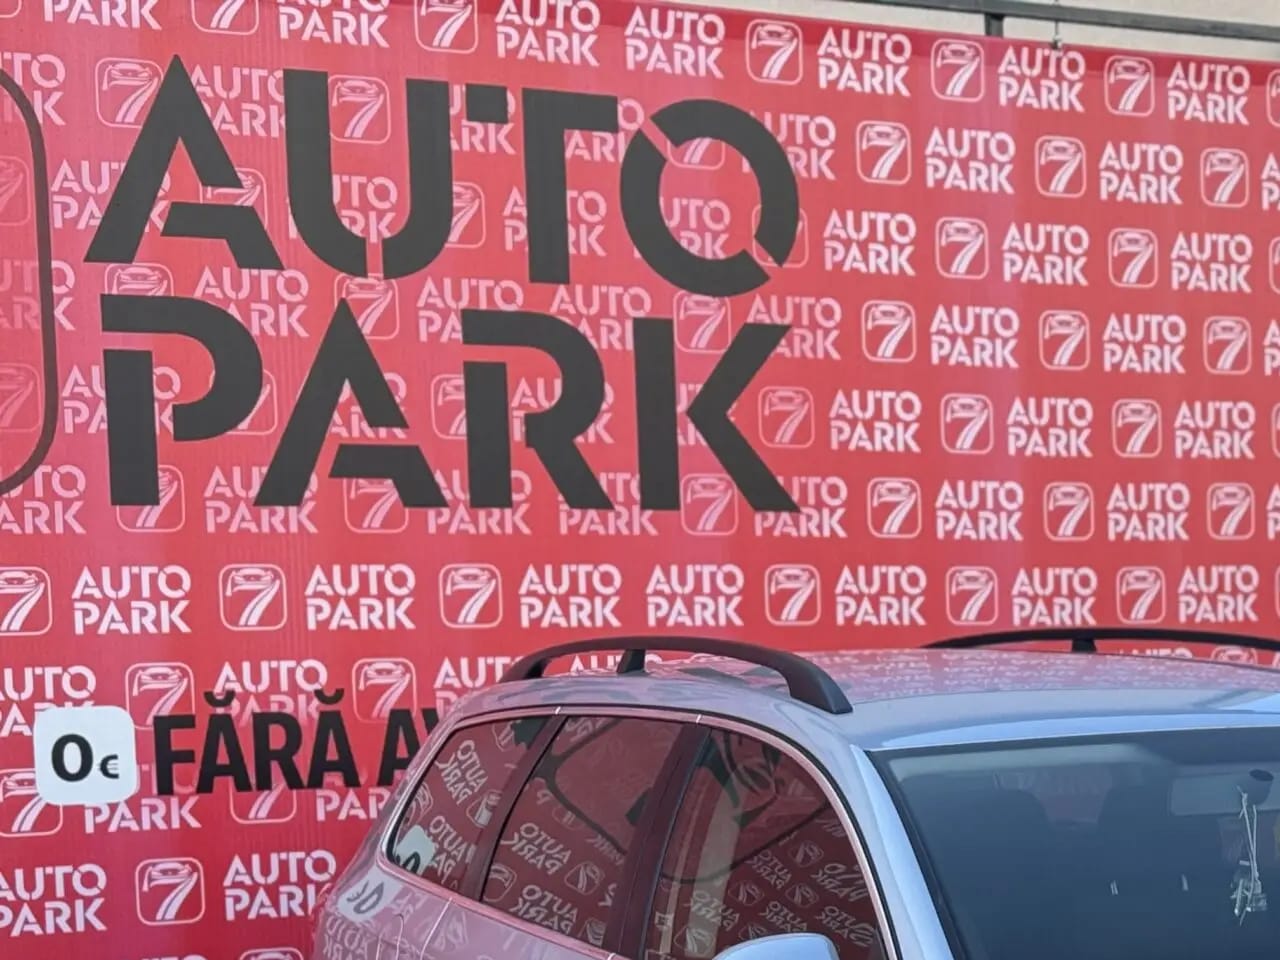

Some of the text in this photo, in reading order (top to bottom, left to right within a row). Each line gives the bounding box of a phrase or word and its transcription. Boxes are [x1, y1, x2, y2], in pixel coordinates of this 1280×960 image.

[44, 0, 162, 31] PARK
[279, 6, 390, 49] PARK
[495, 0, 600, 32] AUTO
[624, 7, 724, 45] AUTO
[496, 25, 599, 67] PARK
[626, 38, 723, 79] PARK
[818, 31, 910, 64] AUTO
[818, 58, 910, 97] PARK
[998, 47, 1084, 80] AUTO
[1168, 64, 1249, 94] AUTO
[999, 75, 1084, 112] PARK
[1168, 90, 1249, 125] PARK
[925, 127, 1016, 162] AUTO
[1099, 142, 1183, 174] AUTO
[84, 54, 801, 298] AUTO
[926, 157, 1014, 194] PARK
[1100, 170, 1182, 204] PARK
[823, 209, 916, 243] AUTO
[1002, 222, 1089, 255] AUTO
[824, 240, 915, 276] PARK
[1170, 232, 1253, 263] AUTO
[193, 266, 309, 302] AUTO
[1003, 251, 1088, 286] PARK
[1171, 259, 1251, 293] PARK
[417, 276, 524, 312] AUTO
[550, 284, 652, 318] AUTO
[747, 294, 843, 327] AUTO
[930, 304, 1020, 337] AUTO
[1102, 314, 1186, 343] AUTO
[931, 334, 1018, 368] PARK
[1104, 342, 1185, 373] PARK
[101, 294, 802, 515] PARK
[829, 389, 922, 421] AUTO
[1006, 397, 1093, 427] AUTO
[1174, 401, 1256, 430] AUTO
[830, 420, 920, 452] PARK
[1008, 426, 1092, 457] PARK
[1175, 429, 1254, 458] PARK
[935, 480, 1024, 510] AUTO
[1106, 483, 1190, 512] AUTO
[205, 501, 319, 534] PARK
[426, 504, 532, 535] PARK
[559, 507, 659, 536] PARK
[754, 508, 848, 538] PARK
[936, 509, 1023, 541] PARK
[1108, 511, 1188, 541] PARK
[72, 565, 191, 599] AUTO
[304, 563, 416, 596] AUTO
[518, 564, 622, 596] AUTO
[646, 564, 744, 595] AUTO
[835, 565, 927, 596] AUTO
[1011, 567, 1098, 597] AUTO
[1178, 565, 1259, 595] AUTO
[74, 600, 192, 635] PARK
[306, 597, 416, 630] PARK
[520, 595, 621, 628] PARK
[647, 594, 744, 627] PARK
[836, 595, 925, 625] PARK
[1012, 596, 1096, 625] PARK
[1179, 592, 1258, 622] PARK
[213, 659, 329, 693] AUTO
[153, 688, 361, 796] FĂRĂ
[84, 796, 202, 834] PARK
[223, 849, 336, 887] AUTO
